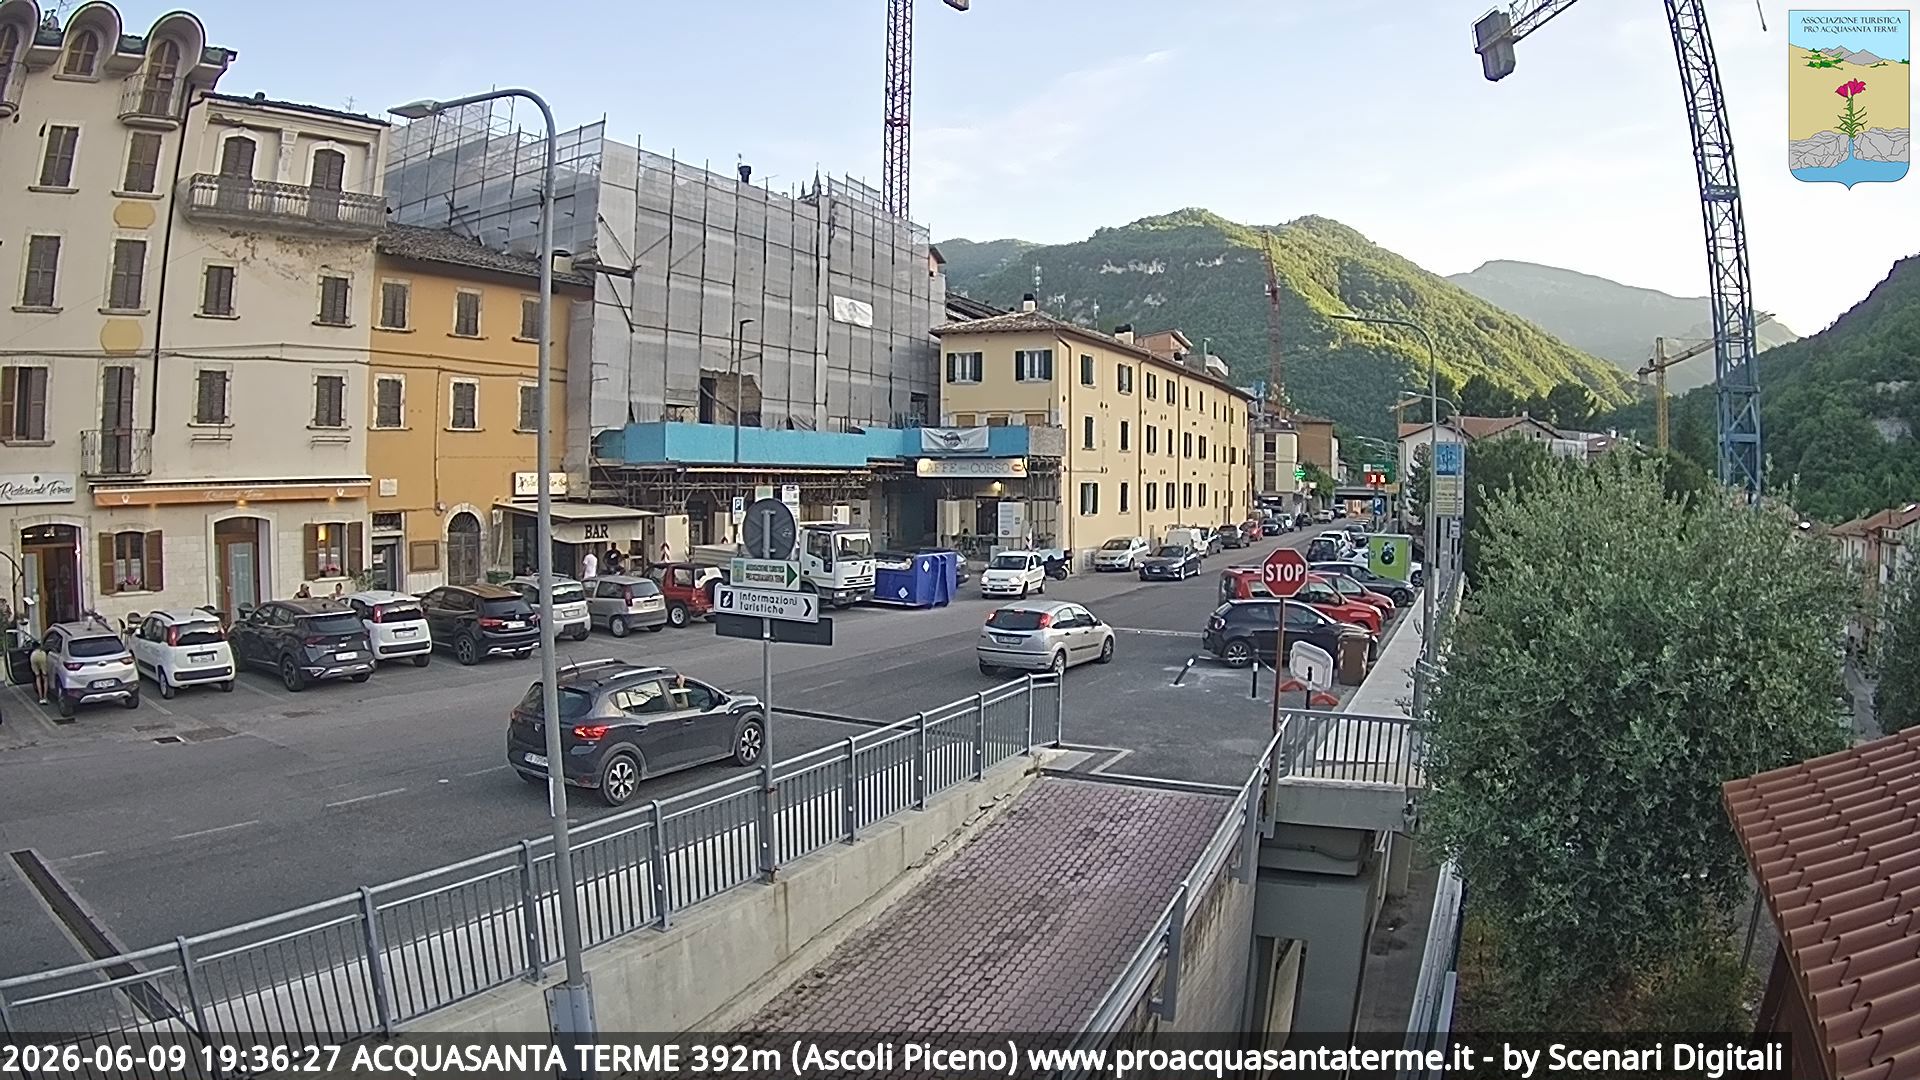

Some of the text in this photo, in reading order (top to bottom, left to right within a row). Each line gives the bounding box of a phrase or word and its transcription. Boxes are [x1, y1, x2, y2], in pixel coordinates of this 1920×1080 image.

[970, 462, 1010, 474] CORSO
[584, 524, 609, 539] BAR
[1265, 563, 1304, 582] STOP
[739, 592, 798, 605] Informazioni
